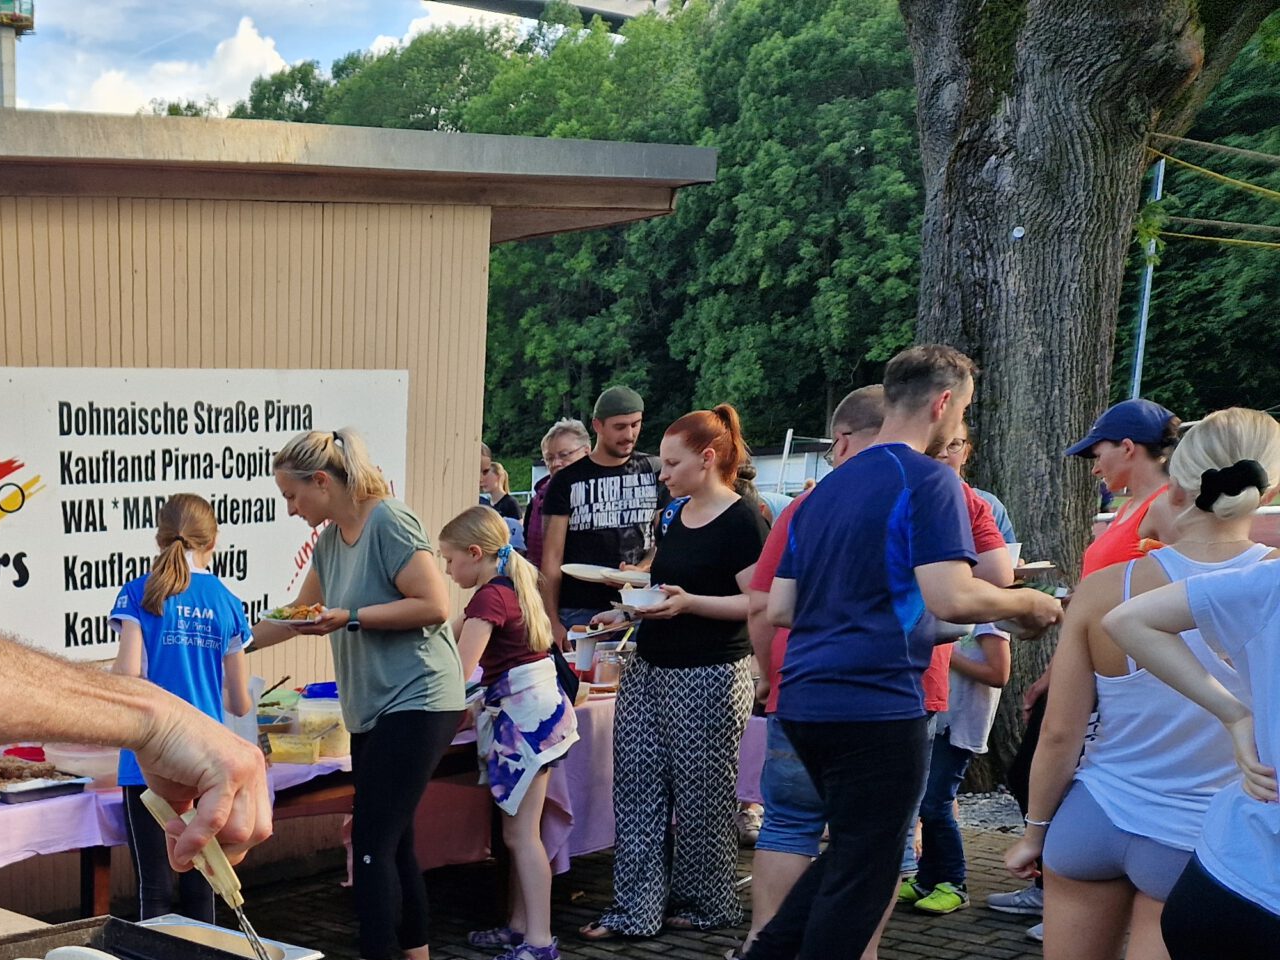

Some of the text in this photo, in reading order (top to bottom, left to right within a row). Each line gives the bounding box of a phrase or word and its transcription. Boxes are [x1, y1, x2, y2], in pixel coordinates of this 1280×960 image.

[58, 399, 313, 436] Dohnaische Straße Pirna
[59, 446, 279, 485] Kaufland Pirna-Copit
[597, 476, 620, 503] EVER
[211, 494, 276, 525] idenau
[593, 498, 641, 513] PEACEFUL
[63, 552, 155, 592] Kauflan
[176, 605, 214, 620] TEAM
